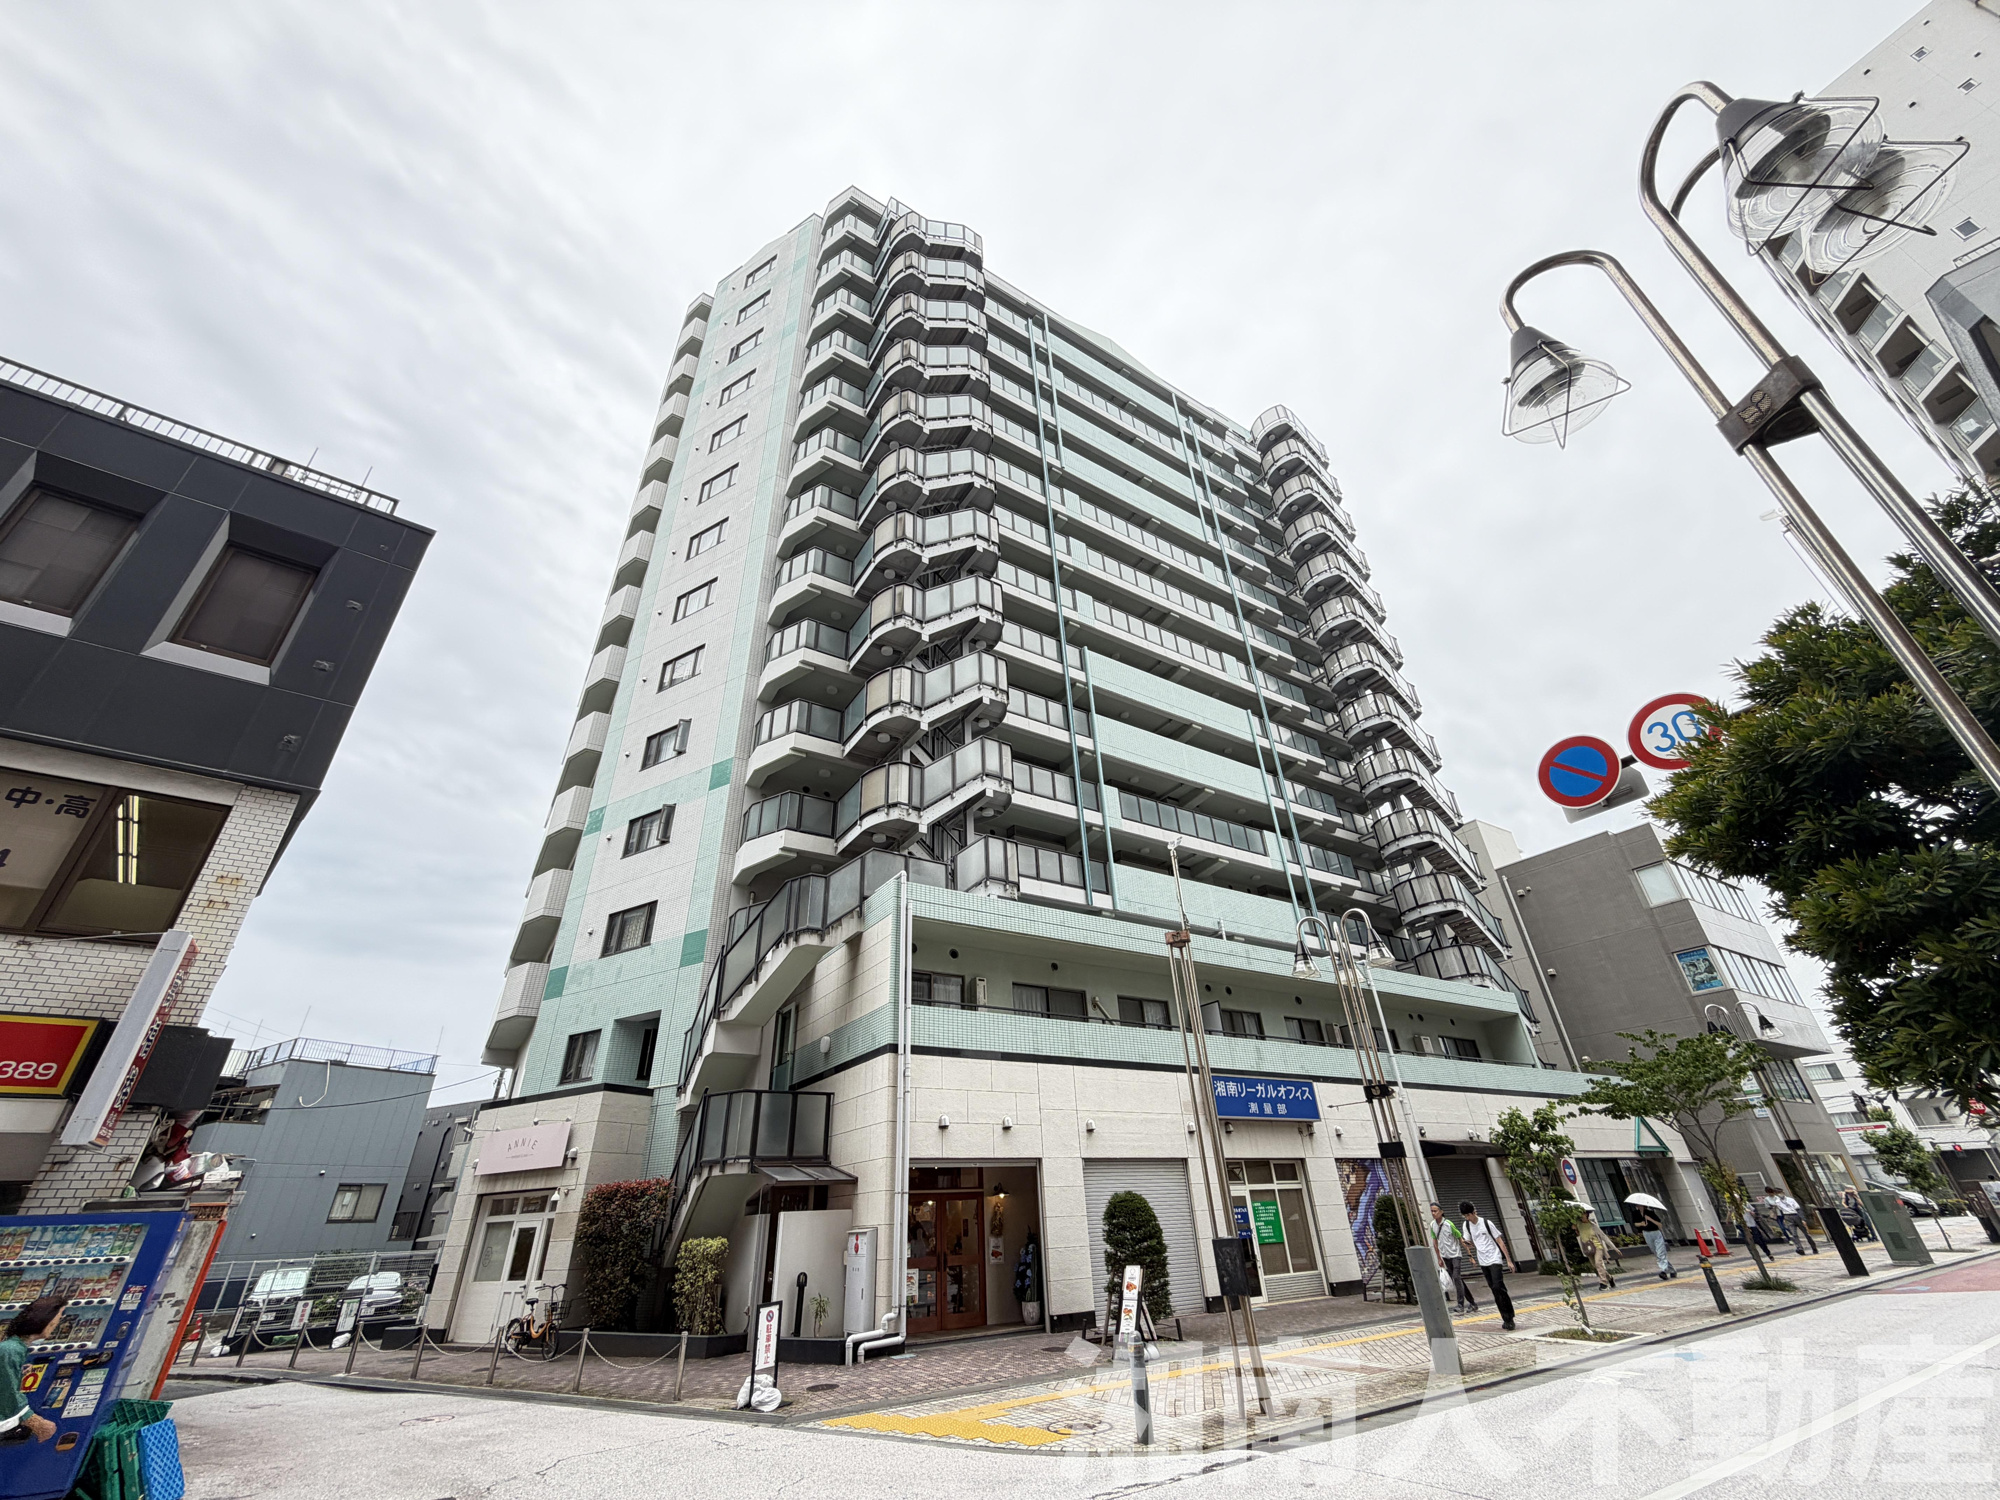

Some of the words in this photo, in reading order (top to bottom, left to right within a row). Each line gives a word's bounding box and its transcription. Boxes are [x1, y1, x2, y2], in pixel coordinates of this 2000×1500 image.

[1647, 711, 1702, 752] 30
[5, 786, 97, 818] 中・高
[1214, 1080, 1312, 1100] 湘南リーガルオフィス
[1248, 1102, 1287, 1115] 測量部
[507, 1138, 538, 1152] ANNIE
[764, 1323, 772, 1364] 駐車禁止
